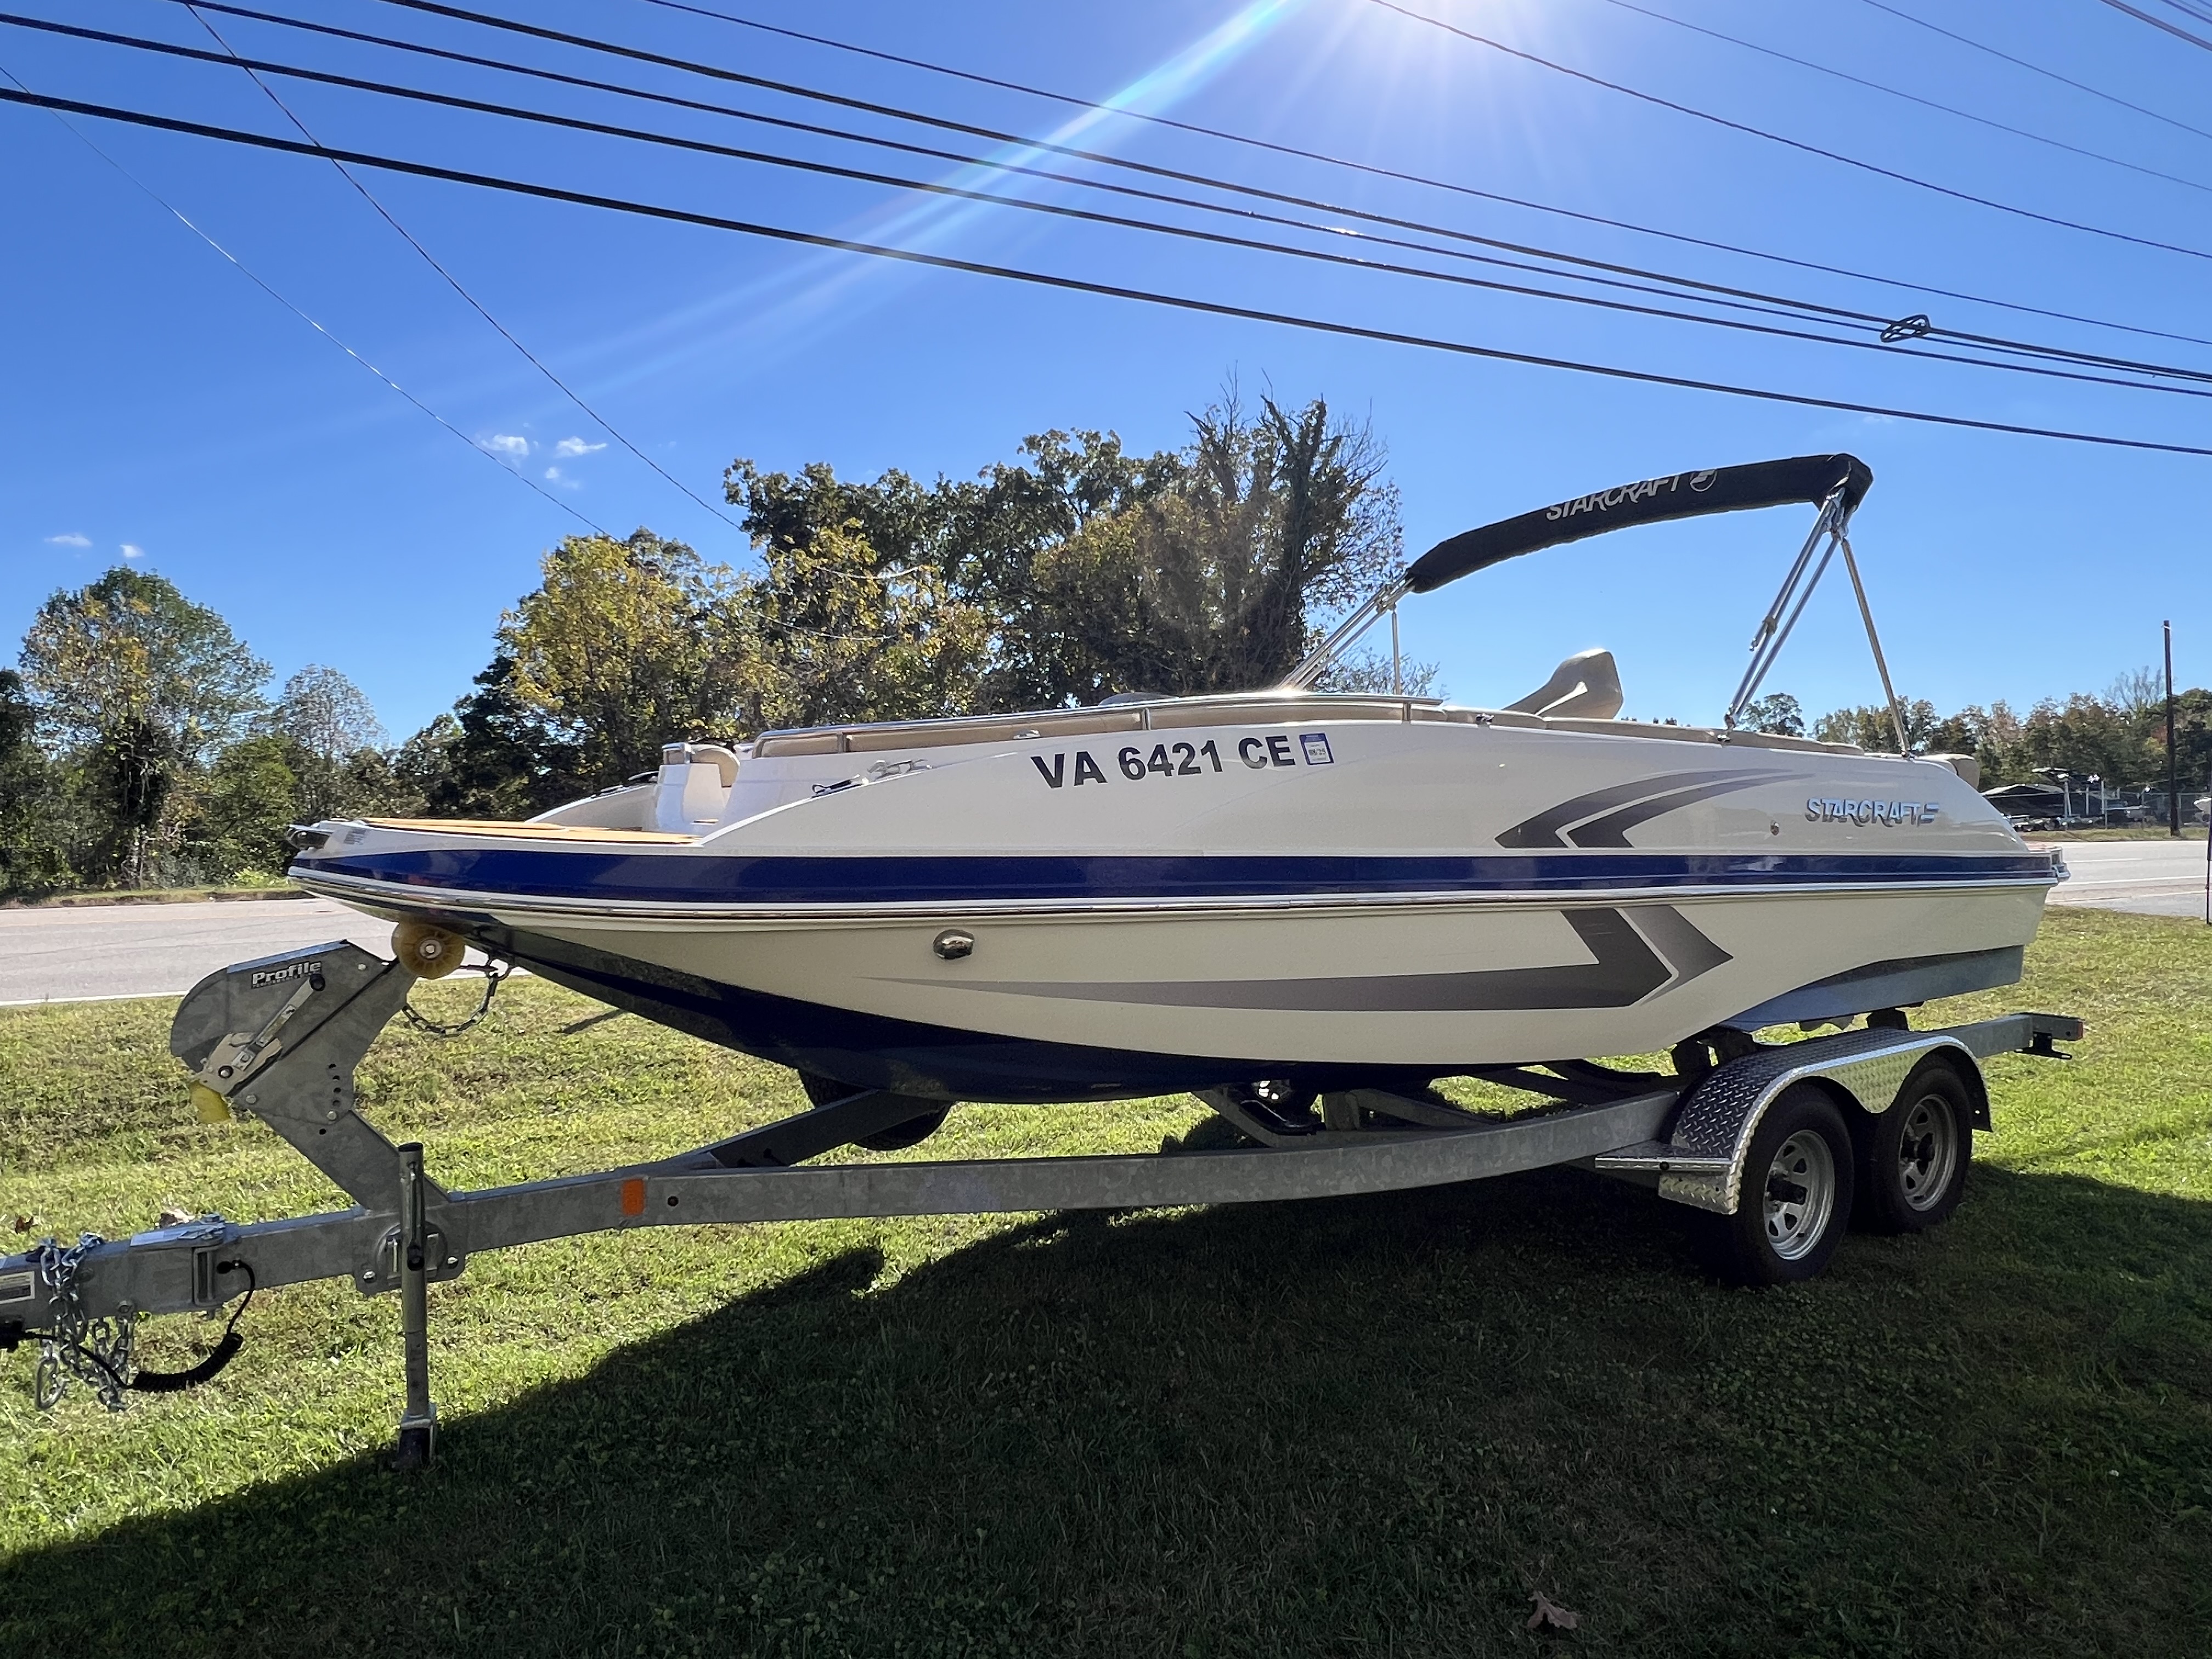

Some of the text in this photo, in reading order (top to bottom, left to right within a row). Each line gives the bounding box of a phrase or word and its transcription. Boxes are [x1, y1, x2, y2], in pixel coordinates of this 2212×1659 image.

[1030, 735, 1295, 788] VA 6421 CE
[1805, 798, 1921, 827] STARCRAFT
[252, 962, 321, 985] Profile
